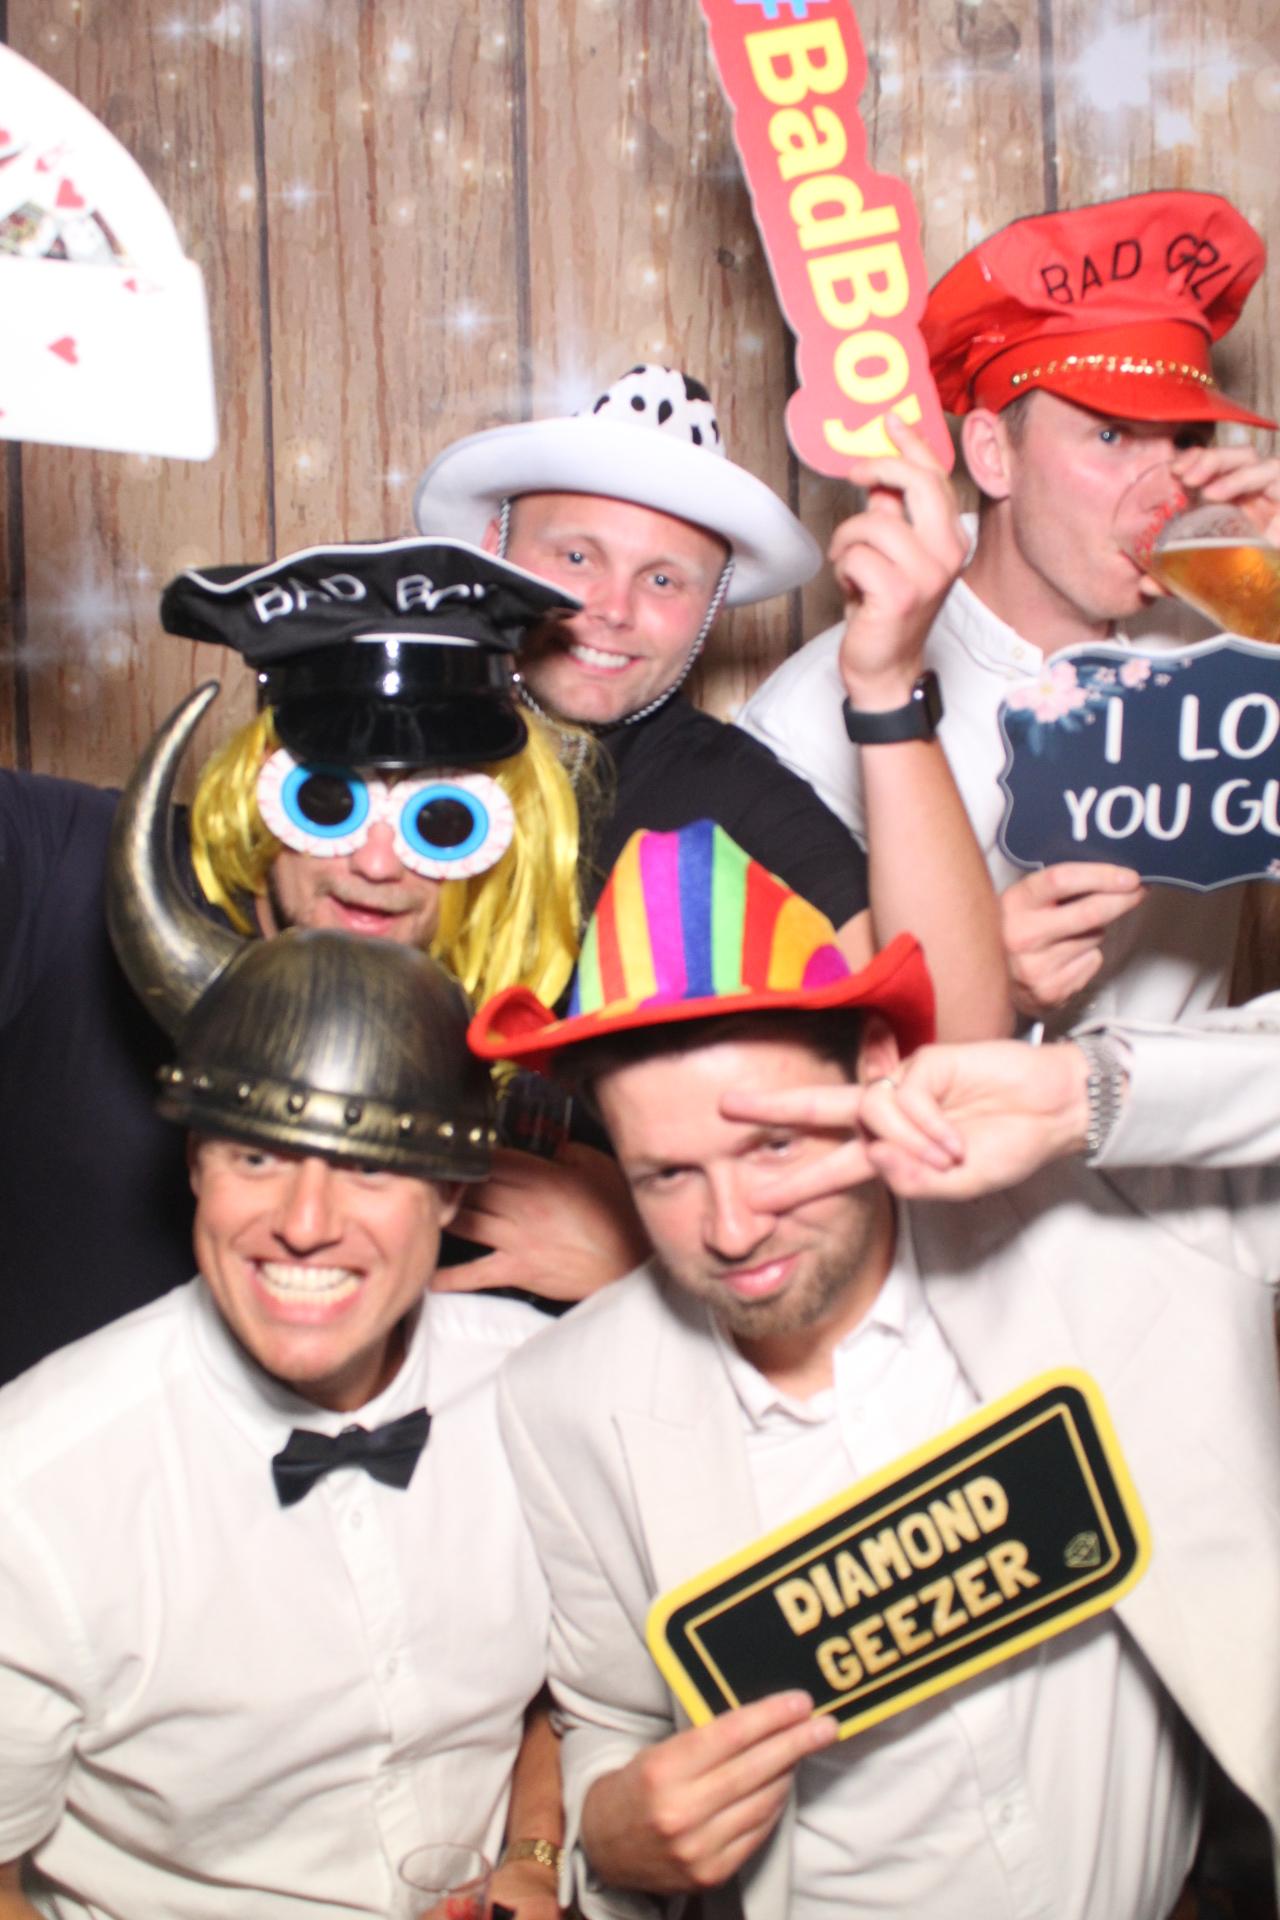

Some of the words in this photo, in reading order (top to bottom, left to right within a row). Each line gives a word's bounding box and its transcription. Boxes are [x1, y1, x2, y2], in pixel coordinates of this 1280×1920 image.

[1040, 239, 1143, 304] BAD
[1104, 696, 1124, 764] I
[1063, 783, 1192, 842] YOU
[773, 1475, 1010, 1636] DIAMOND
[815, 1540, 1041, 1692] GEEZER
